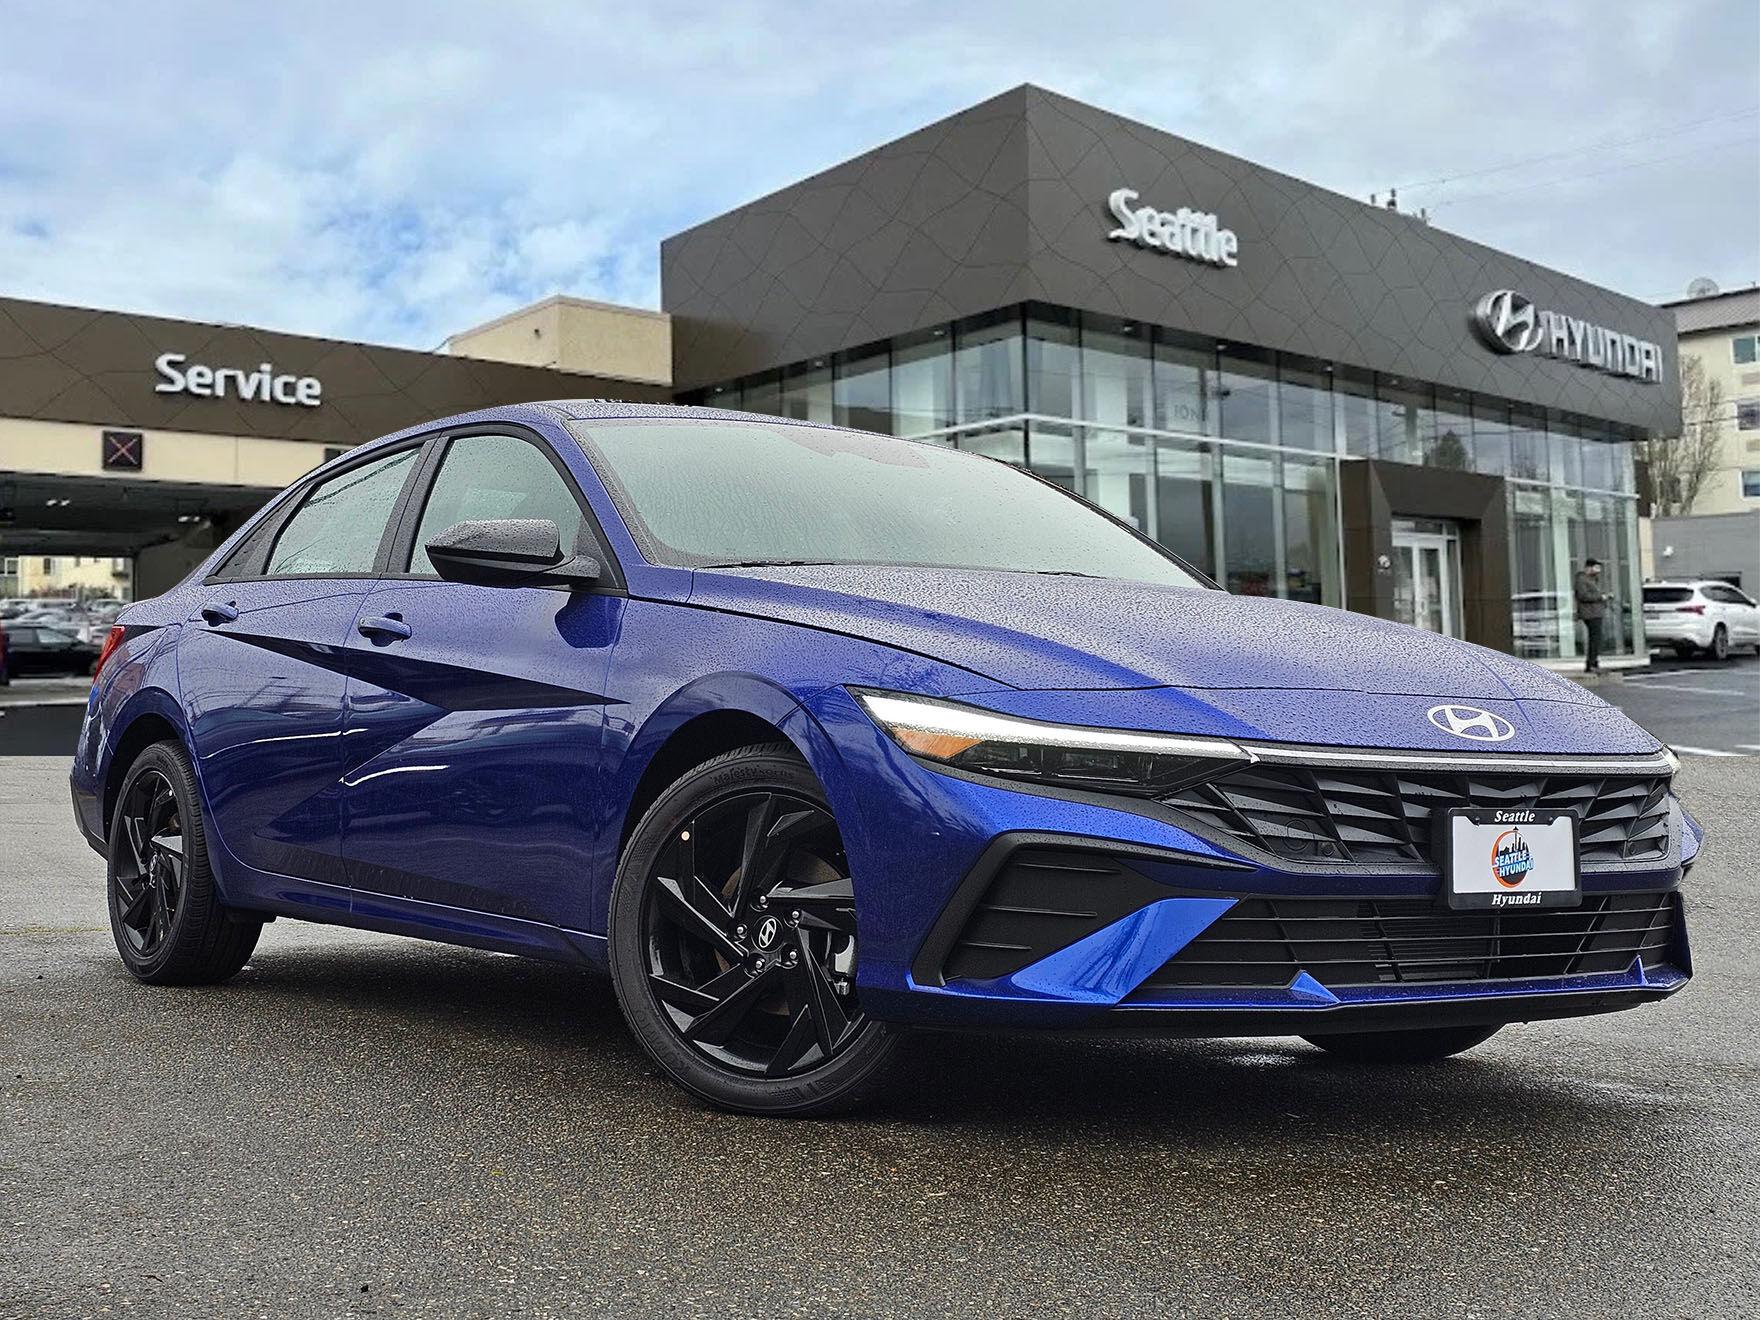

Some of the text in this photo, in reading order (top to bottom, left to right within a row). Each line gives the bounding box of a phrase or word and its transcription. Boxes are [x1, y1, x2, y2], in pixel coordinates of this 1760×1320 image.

[1108, 188, 1238, 266] Seattle
[1541, 310, 1663, 383] HYUNDAI
[154, 353, 322, 406] Service
[1494, 811, 1535, 822] Seattle
[1494, 851, 1527, 868] SEATTLE
[1492, 892, 1541, 907] Hyundai
